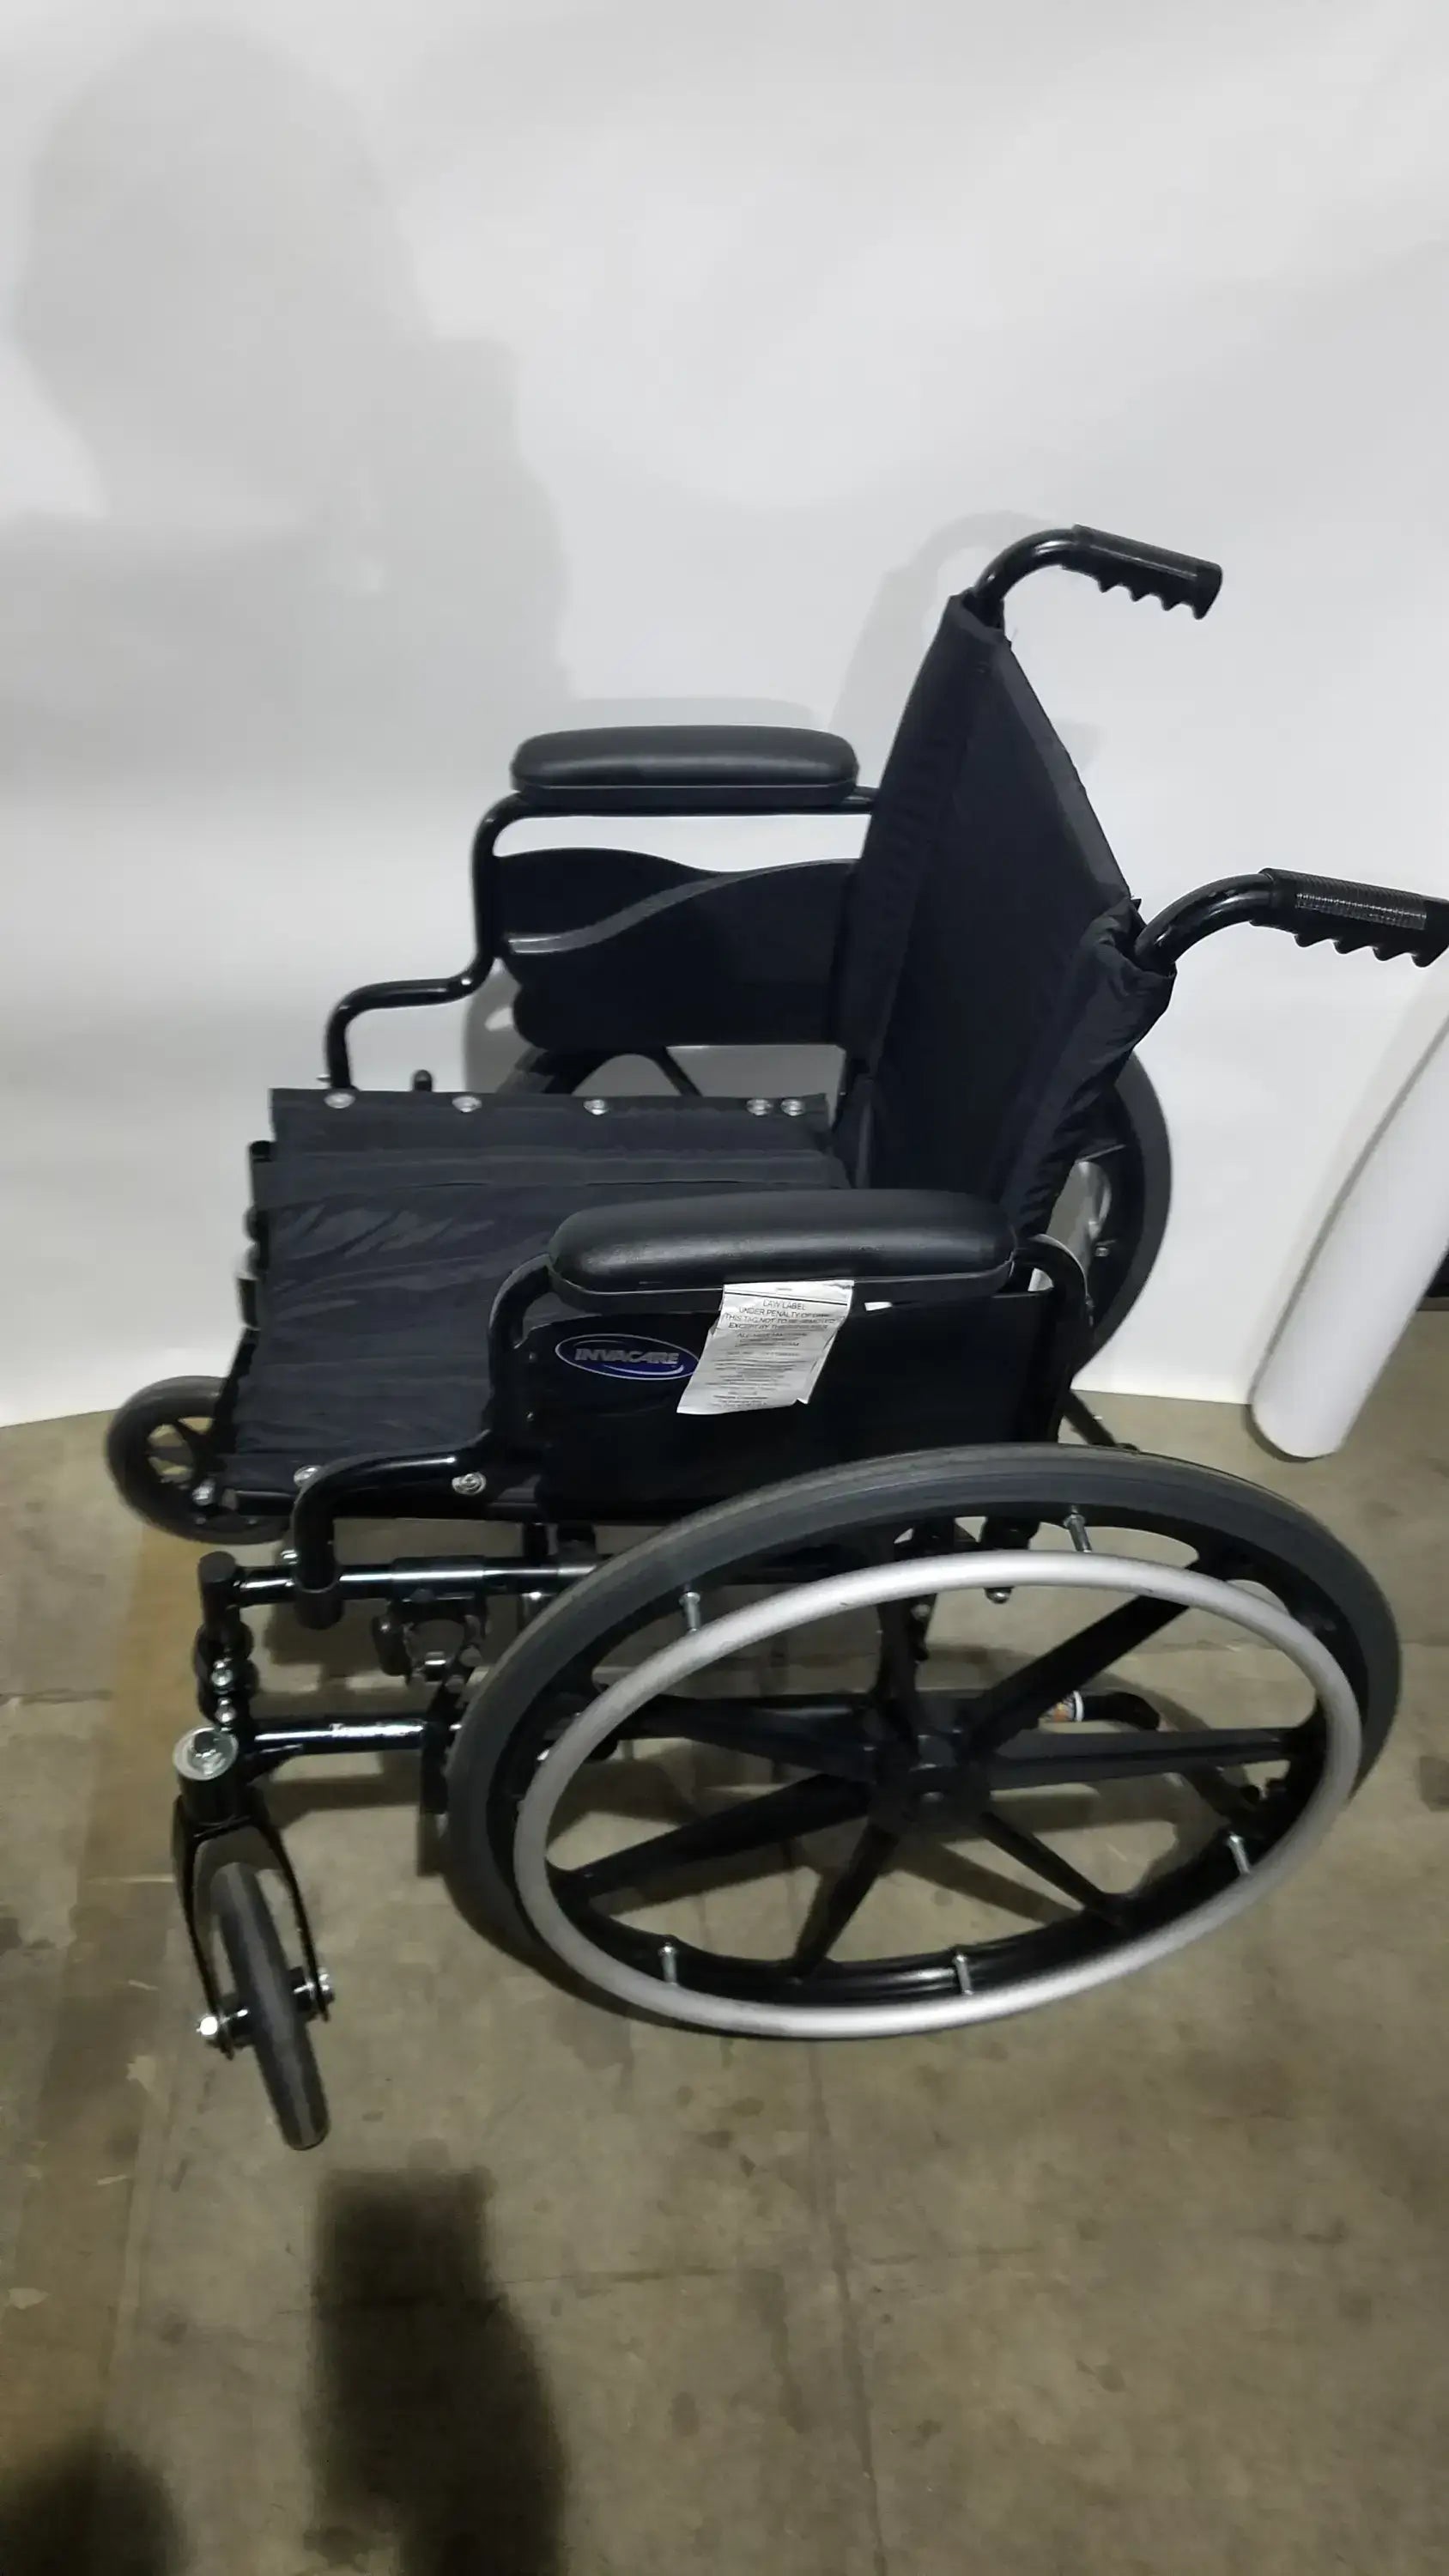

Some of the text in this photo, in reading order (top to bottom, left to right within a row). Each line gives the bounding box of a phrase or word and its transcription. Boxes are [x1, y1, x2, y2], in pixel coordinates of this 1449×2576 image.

[763, 1299, 806, 1310] LAW LABEL
[725, 1313, 742, 1322] THIS
[574, 1348, 680, 1364] INVACARE
